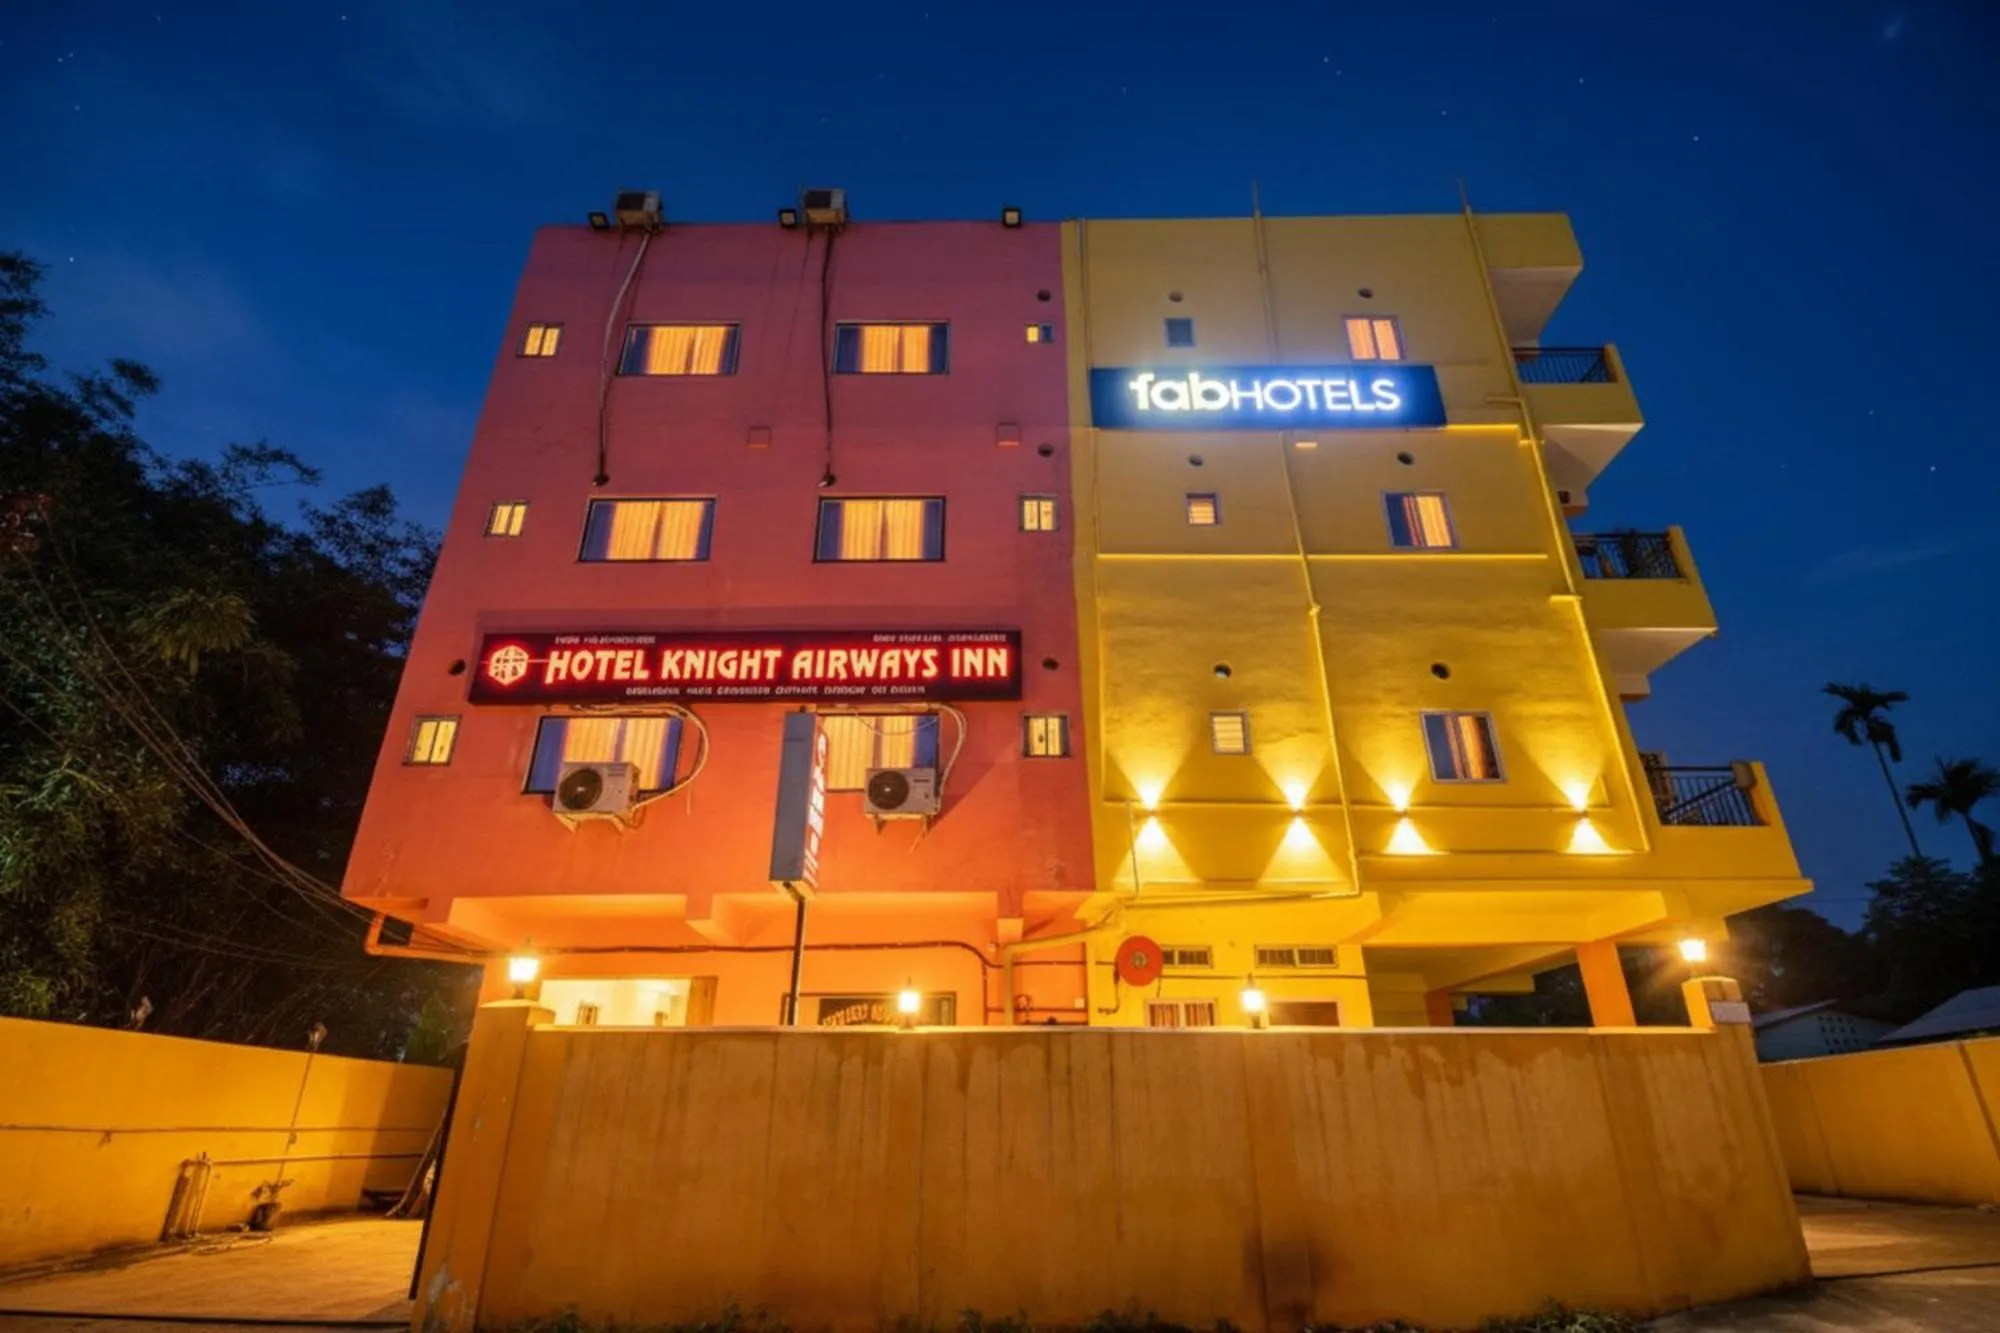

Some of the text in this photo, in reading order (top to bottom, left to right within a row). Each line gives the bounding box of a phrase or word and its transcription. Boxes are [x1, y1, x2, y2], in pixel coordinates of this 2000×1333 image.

[544, 647, 1008, 684] HOTEL KNIGHT AIRWAYS INN
